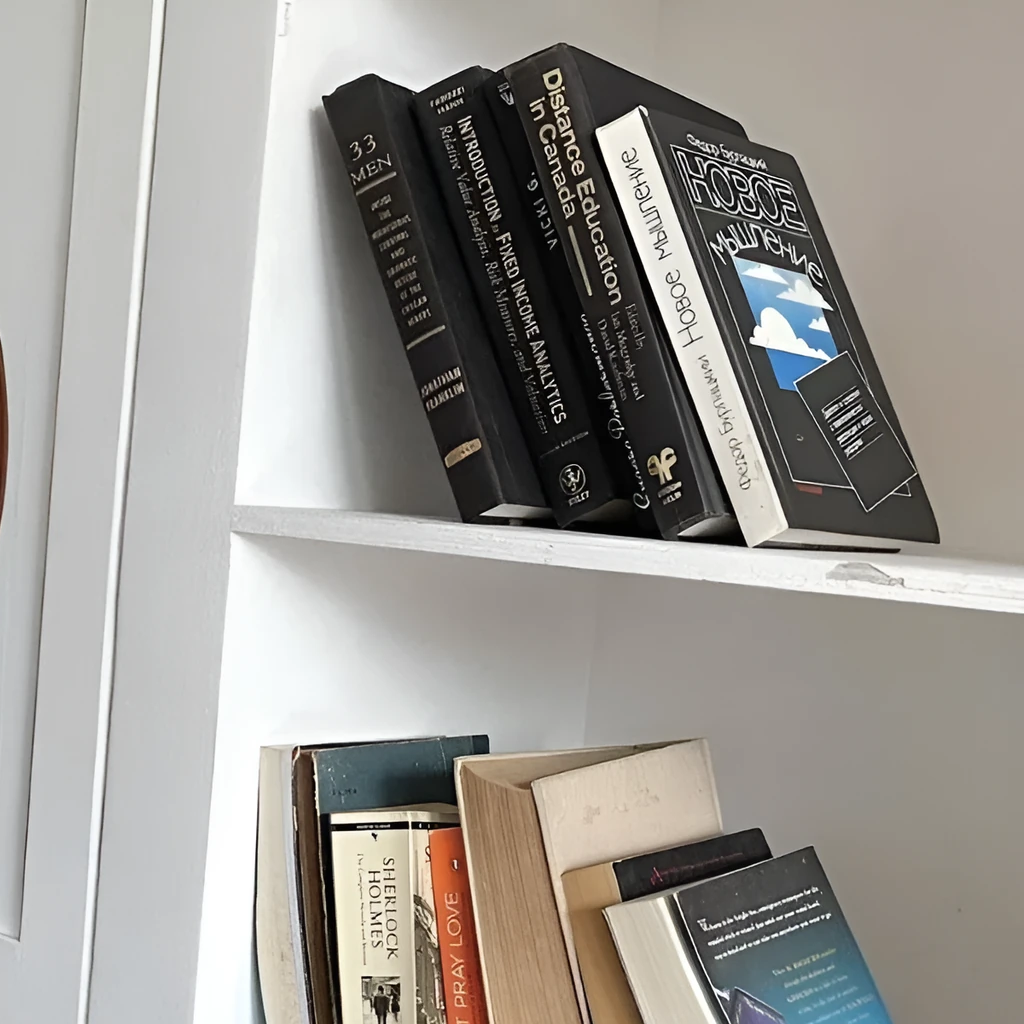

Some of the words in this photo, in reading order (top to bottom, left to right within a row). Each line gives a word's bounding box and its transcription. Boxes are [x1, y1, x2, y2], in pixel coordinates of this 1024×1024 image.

[349, 134, 377, 161] 33
[351, 153, 392, 186] MEN
[539, 123, 576, 220] Canada
[542, 67, 585, 177] Distance
[576, 177, 622, 306] Education
[533, 198, 558, 251] VICKI
[621, 147, 673, 261] мышление
[676, 150, 808, 233] НОВОЕ
[496, 232, 521, 279] FIXED
[511, 278, 540, 340] INCOME
[529, 340, 567, 425] ANALYTICS
[665, 268, 704, 349] Новое
[368, 870, 384, 949] HOLMES
[382, 857, 399, 960] SHERLOCK
[444, 892, 463, 947] LOVE
[449, 954, 468, 1008] PRAY
